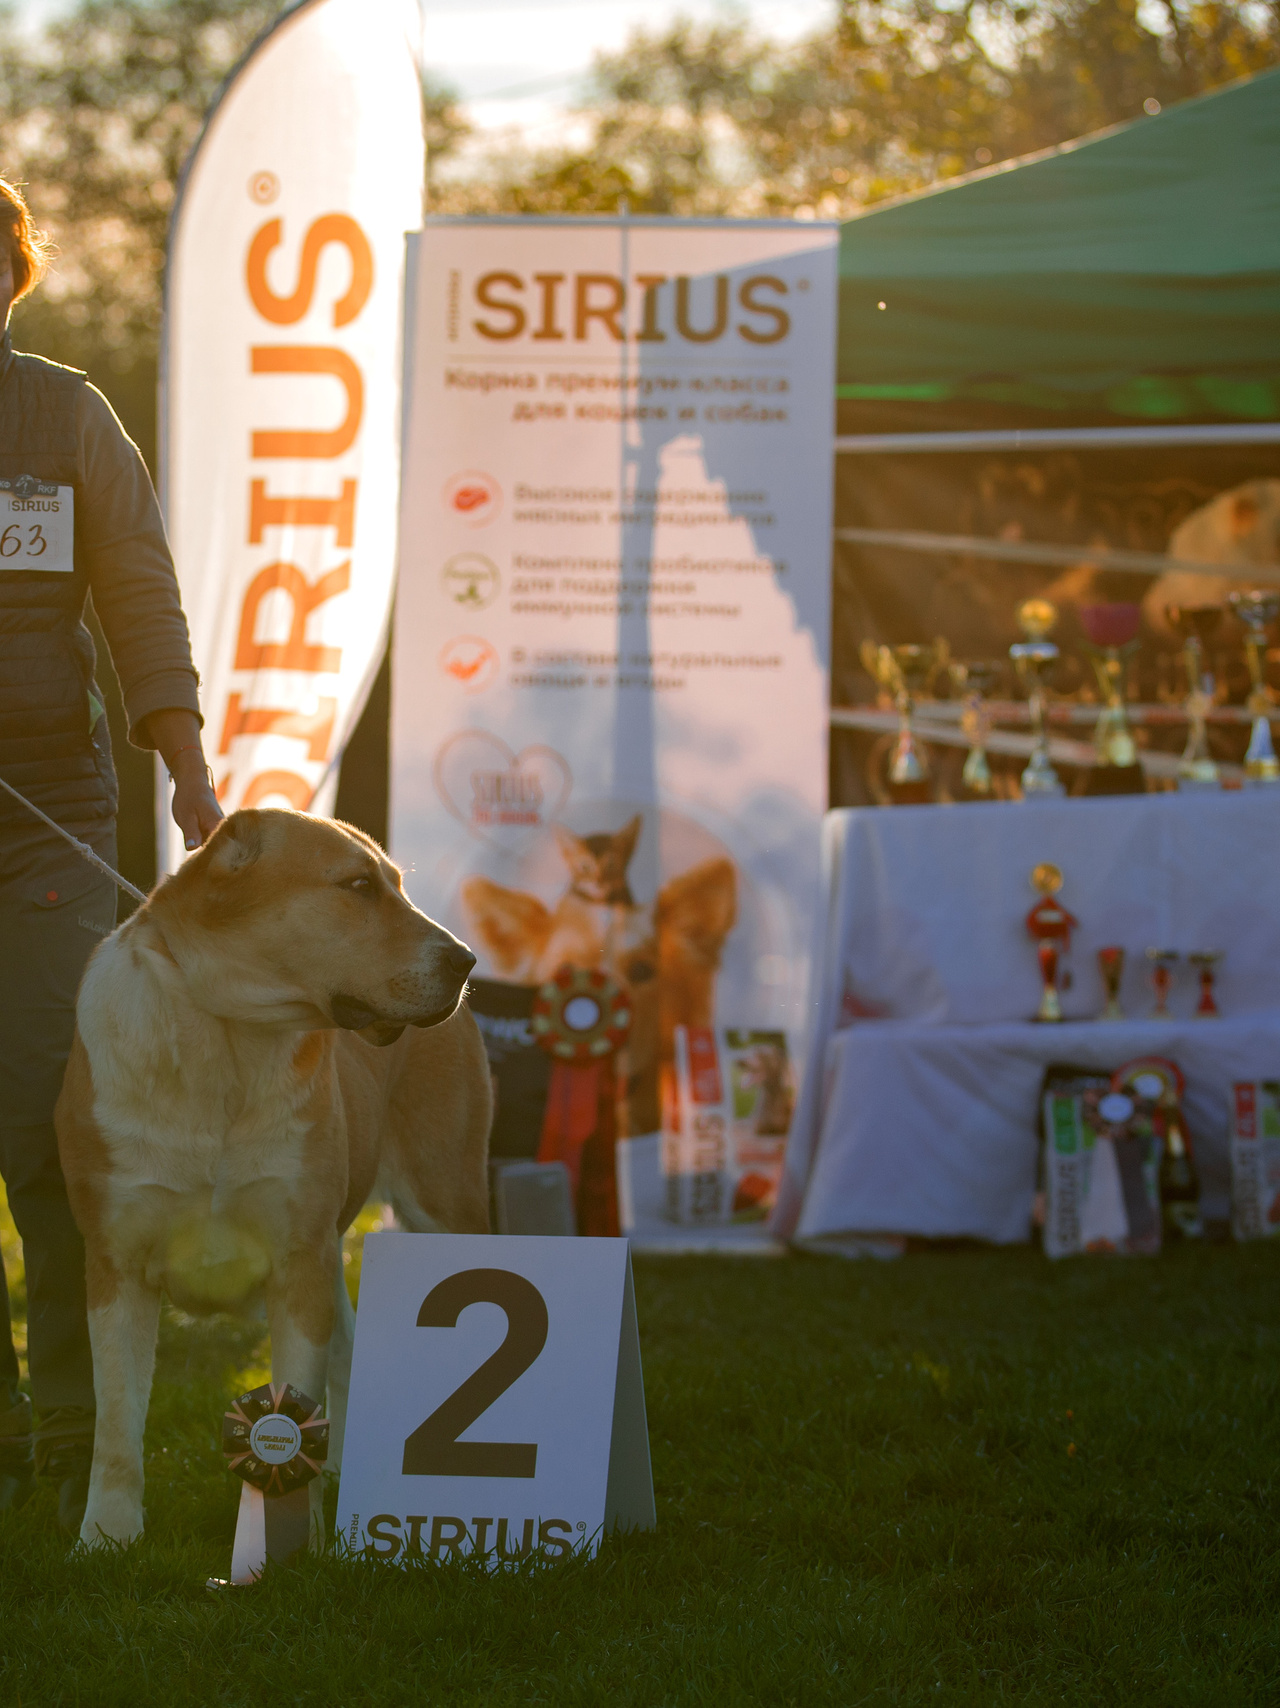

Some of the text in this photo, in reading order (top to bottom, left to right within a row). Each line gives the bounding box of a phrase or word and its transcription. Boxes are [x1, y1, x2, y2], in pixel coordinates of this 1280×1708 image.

[473, 270, 793, 346] SIRIUS
[11, 500, 61, 512] SIRIUS
[37, 484, 57, 494] RKF
[0, 524, 47, 557] 63
[402, 1268, 549, 1478] 2
[350, 1513, 361, 1554] PREMIU
